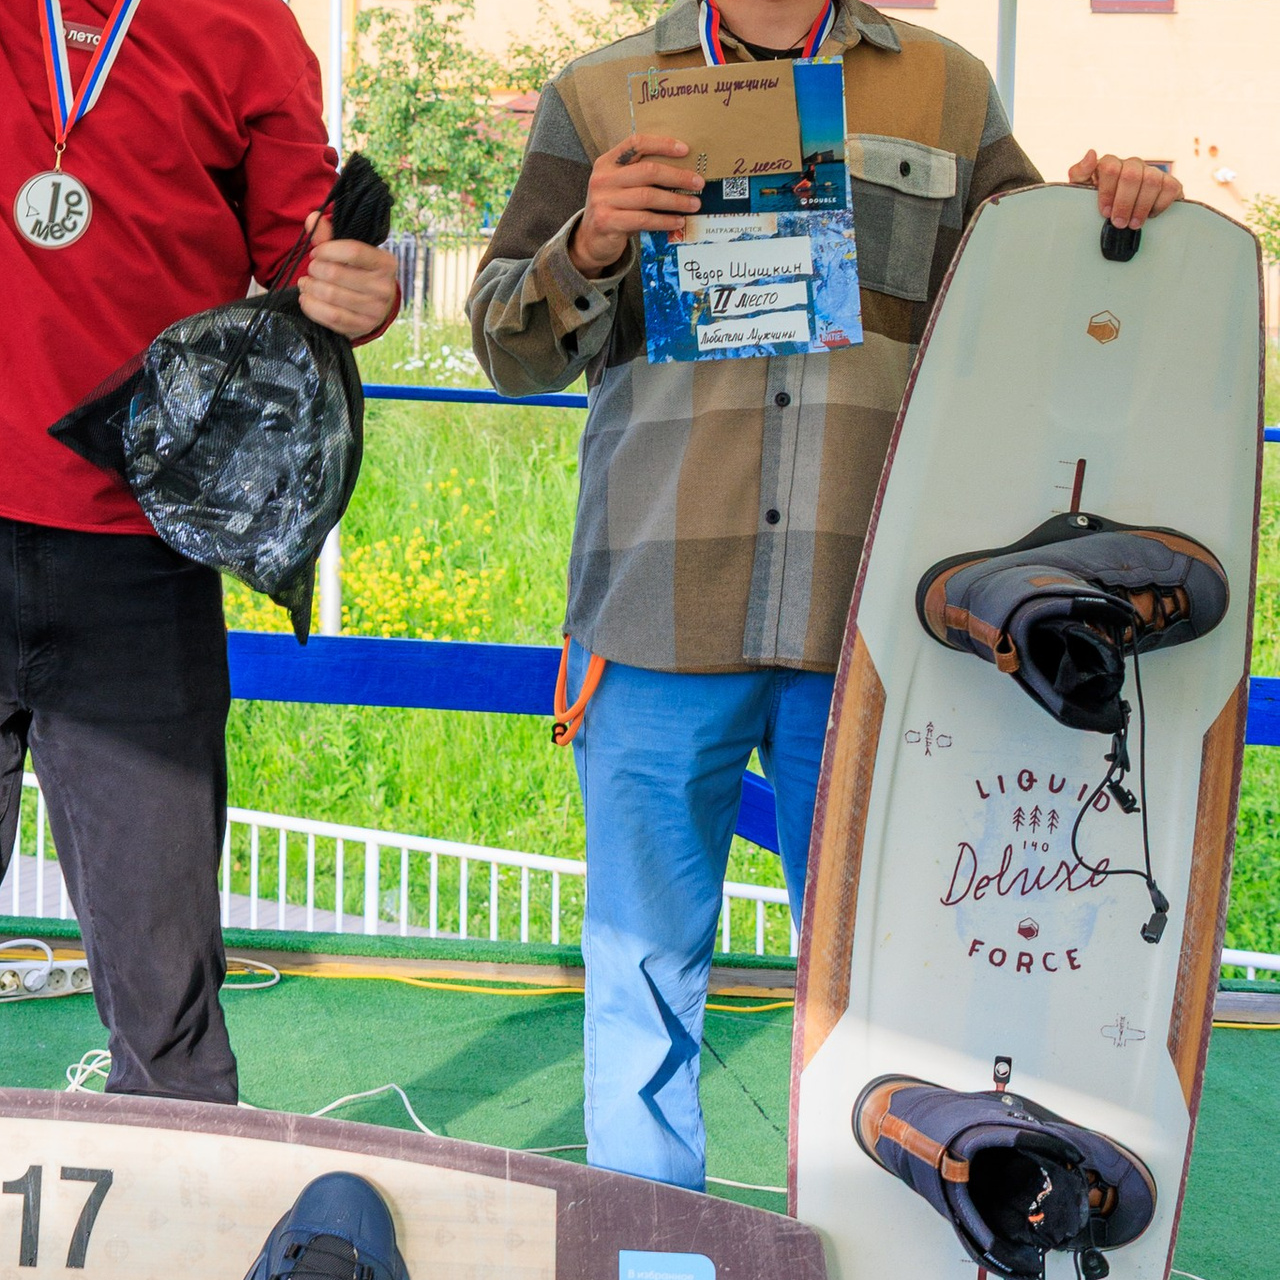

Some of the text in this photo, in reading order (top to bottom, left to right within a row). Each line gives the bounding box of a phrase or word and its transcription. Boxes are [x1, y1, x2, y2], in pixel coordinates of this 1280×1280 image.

[714, 77, 780, 107] мужчины
[733, 157, 792, 175] 2 место
[48, 181, 62, 223] 1
[808, 196, 837, 205] DOUBLE
[684, 259, 802, 286] Федор Шишкин
[700, 328, 744, 345] Любители
[976, 769, 1111, 813] LIQUID
[1022, 840, 1050, 853] 140
[940, 842, 1111, 907] Deluxe
[968, 938, 1083, 973] FORCE
[2, 1165, 114, 1269] 17
